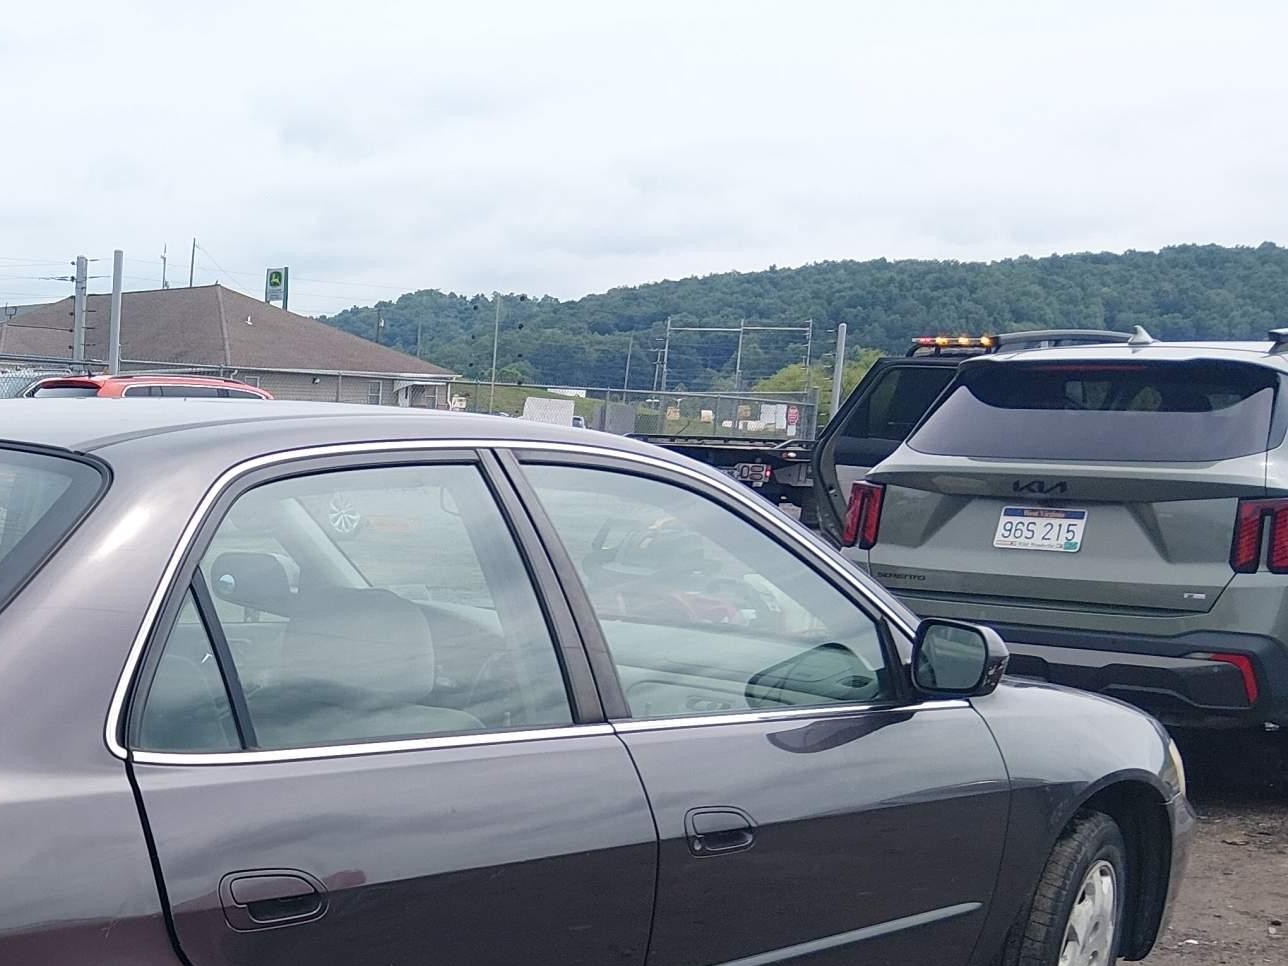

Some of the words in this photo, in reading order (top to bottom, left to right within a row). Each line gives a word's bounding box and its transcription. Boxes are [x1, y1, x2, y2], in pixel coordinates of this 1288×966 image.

[1013, 480, 1067, 494] KIA
[1001, 521, 1037, 540] 96S
[1041, 522, 1078, 542] 215
